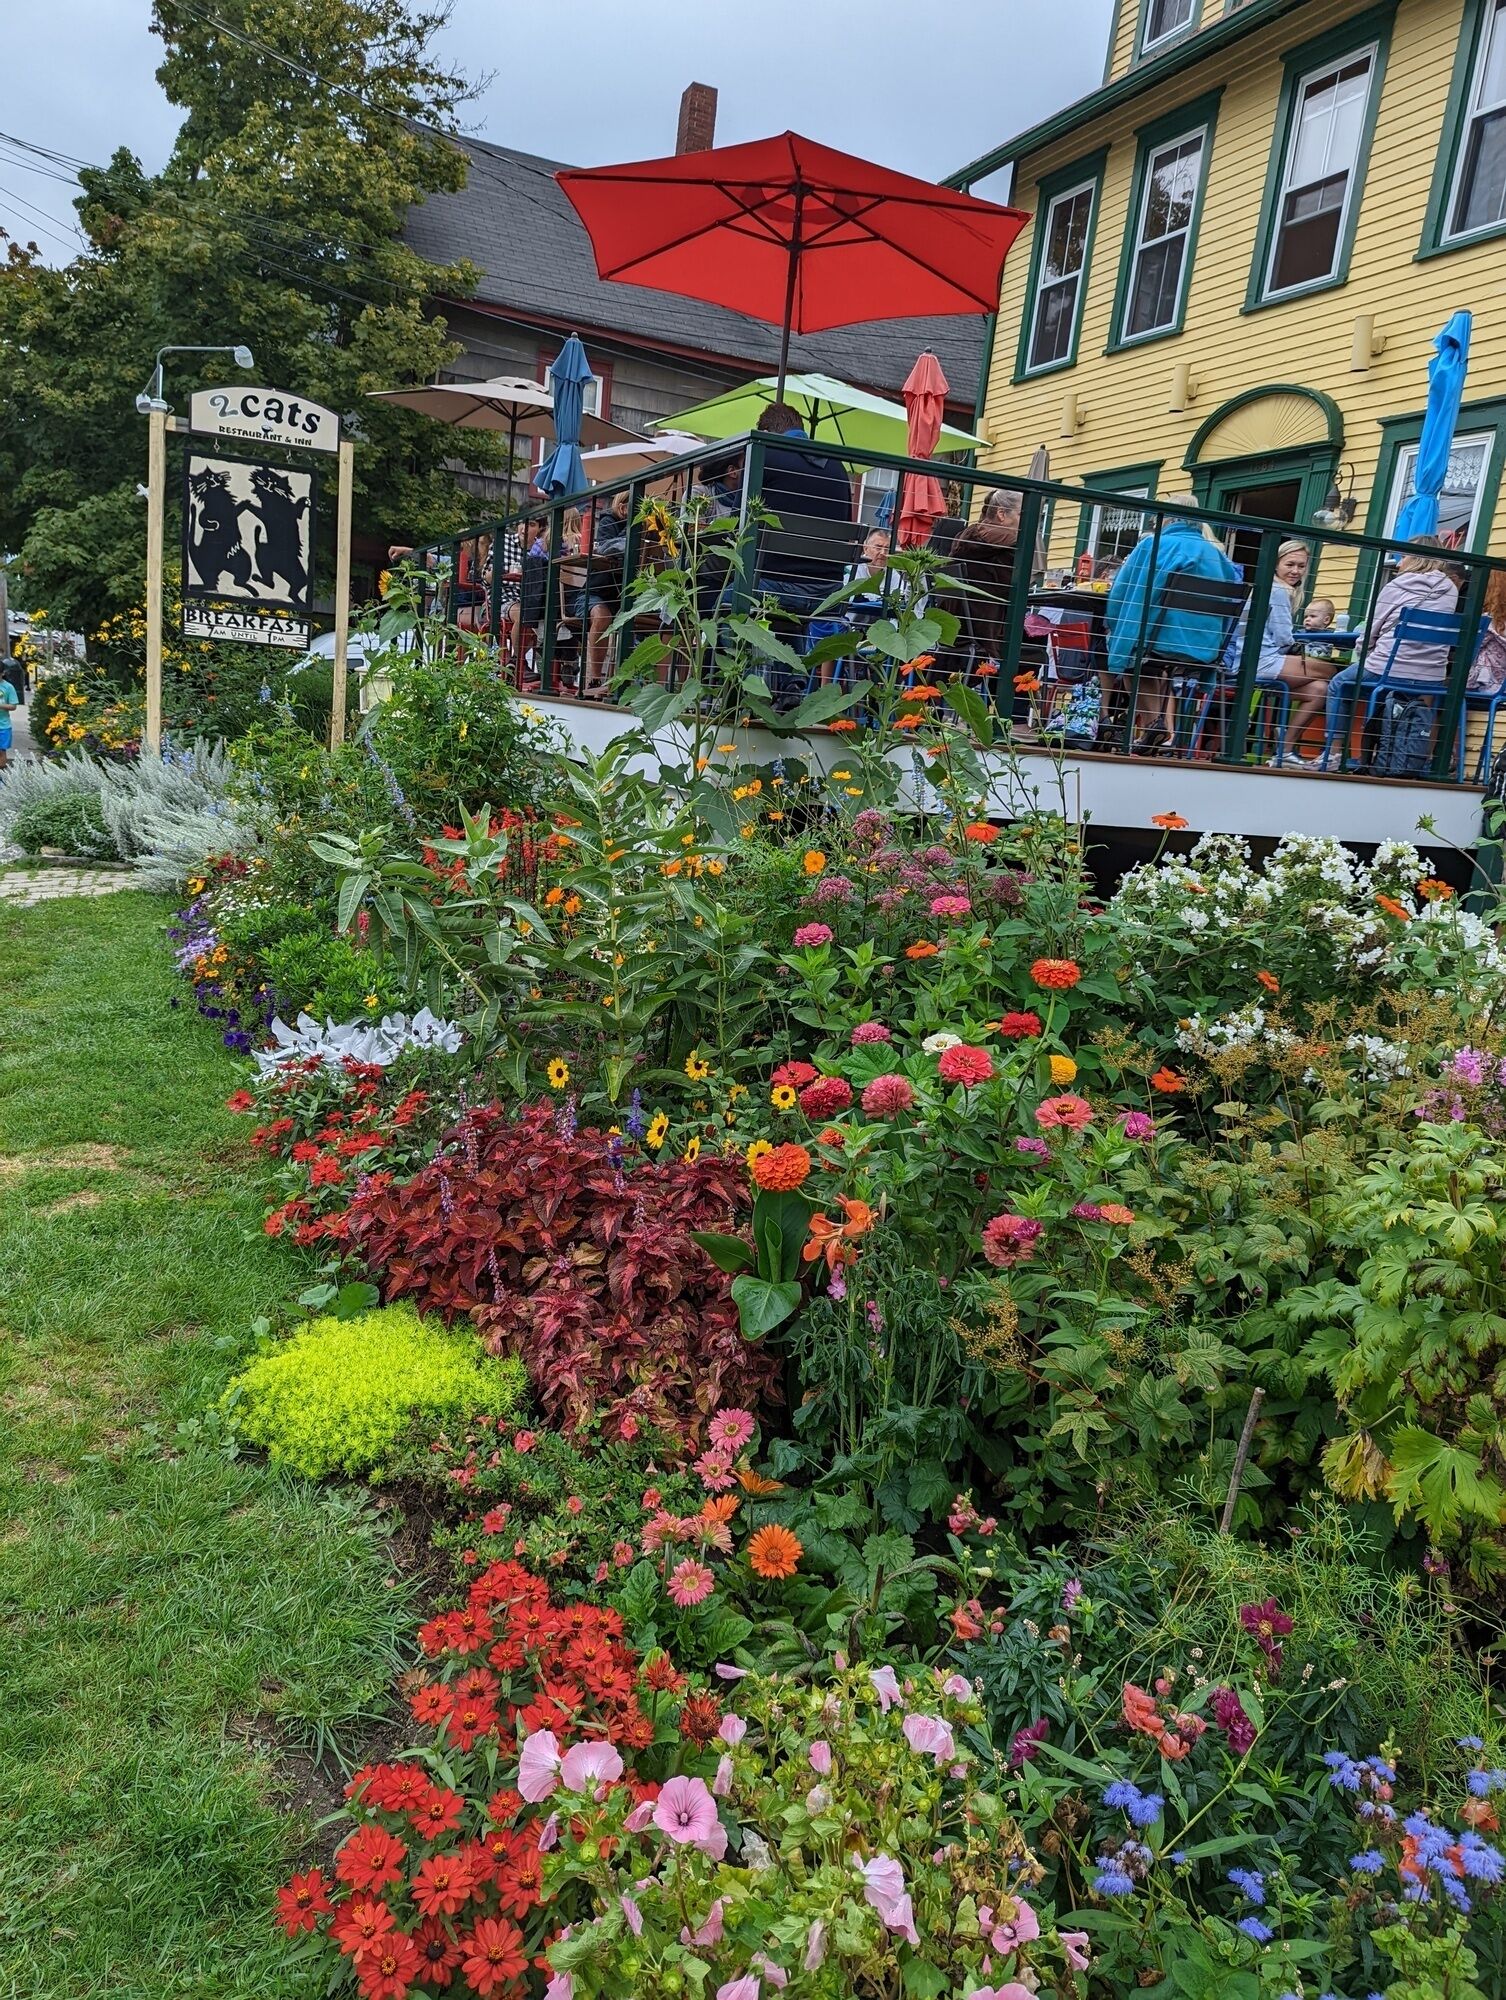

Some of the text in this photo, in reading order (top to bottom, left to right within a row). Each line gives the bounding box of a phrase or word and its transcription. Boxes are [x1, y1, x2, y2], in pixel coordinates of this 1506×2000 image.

[218, 425, 312, 447] RESTAURANT & INN
[186, 608, 308, 634] BREAKFAST
[231, 631, 257, 640] UNTIL
